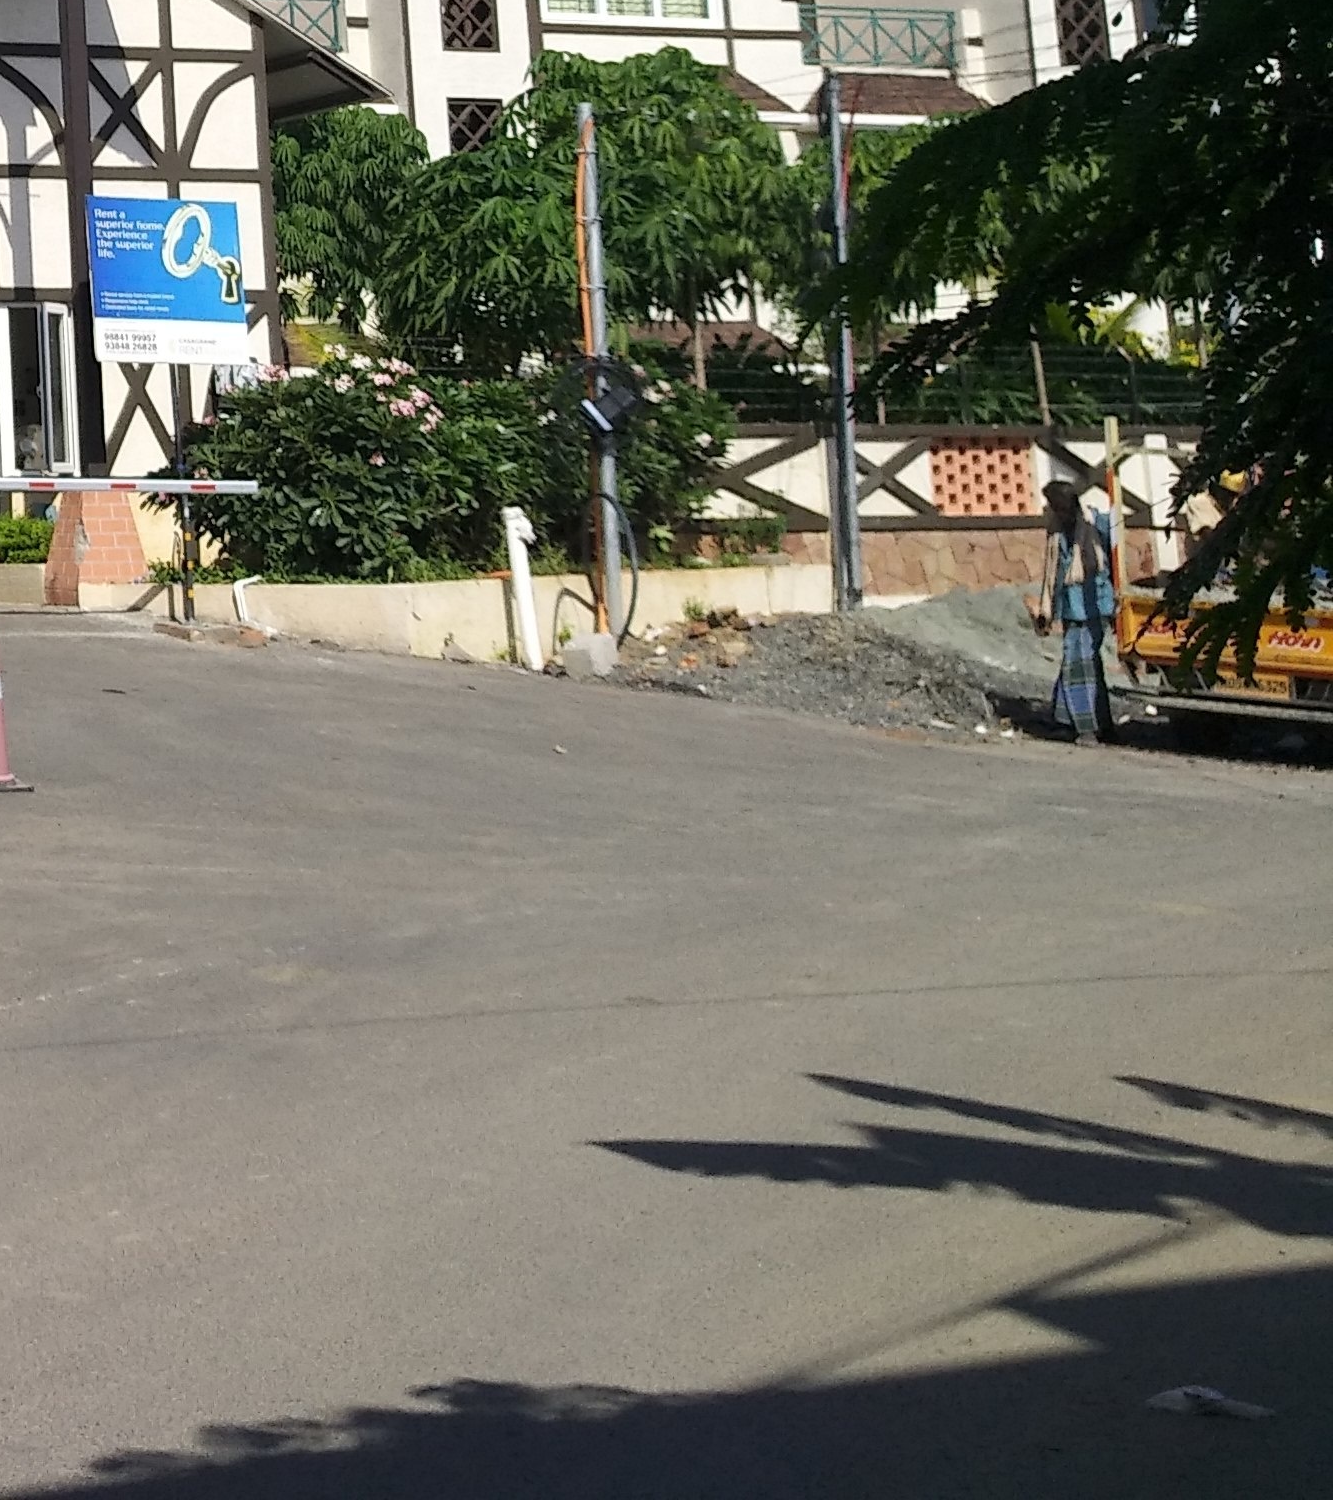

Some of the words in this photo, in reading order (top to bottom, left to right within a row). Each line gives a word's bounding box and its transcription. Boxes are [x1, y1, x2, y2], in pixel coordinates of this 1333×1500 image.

[93, 208, 117, 219] Rent
[119, 211, 126, 219] a
[95, 220, 134, 230] superior
[96, 229, 148, 240] Experience
[97, 239, 113, 248] the
[115, 241, 154, 251] superior
[97, 248, 116, 259] life.
